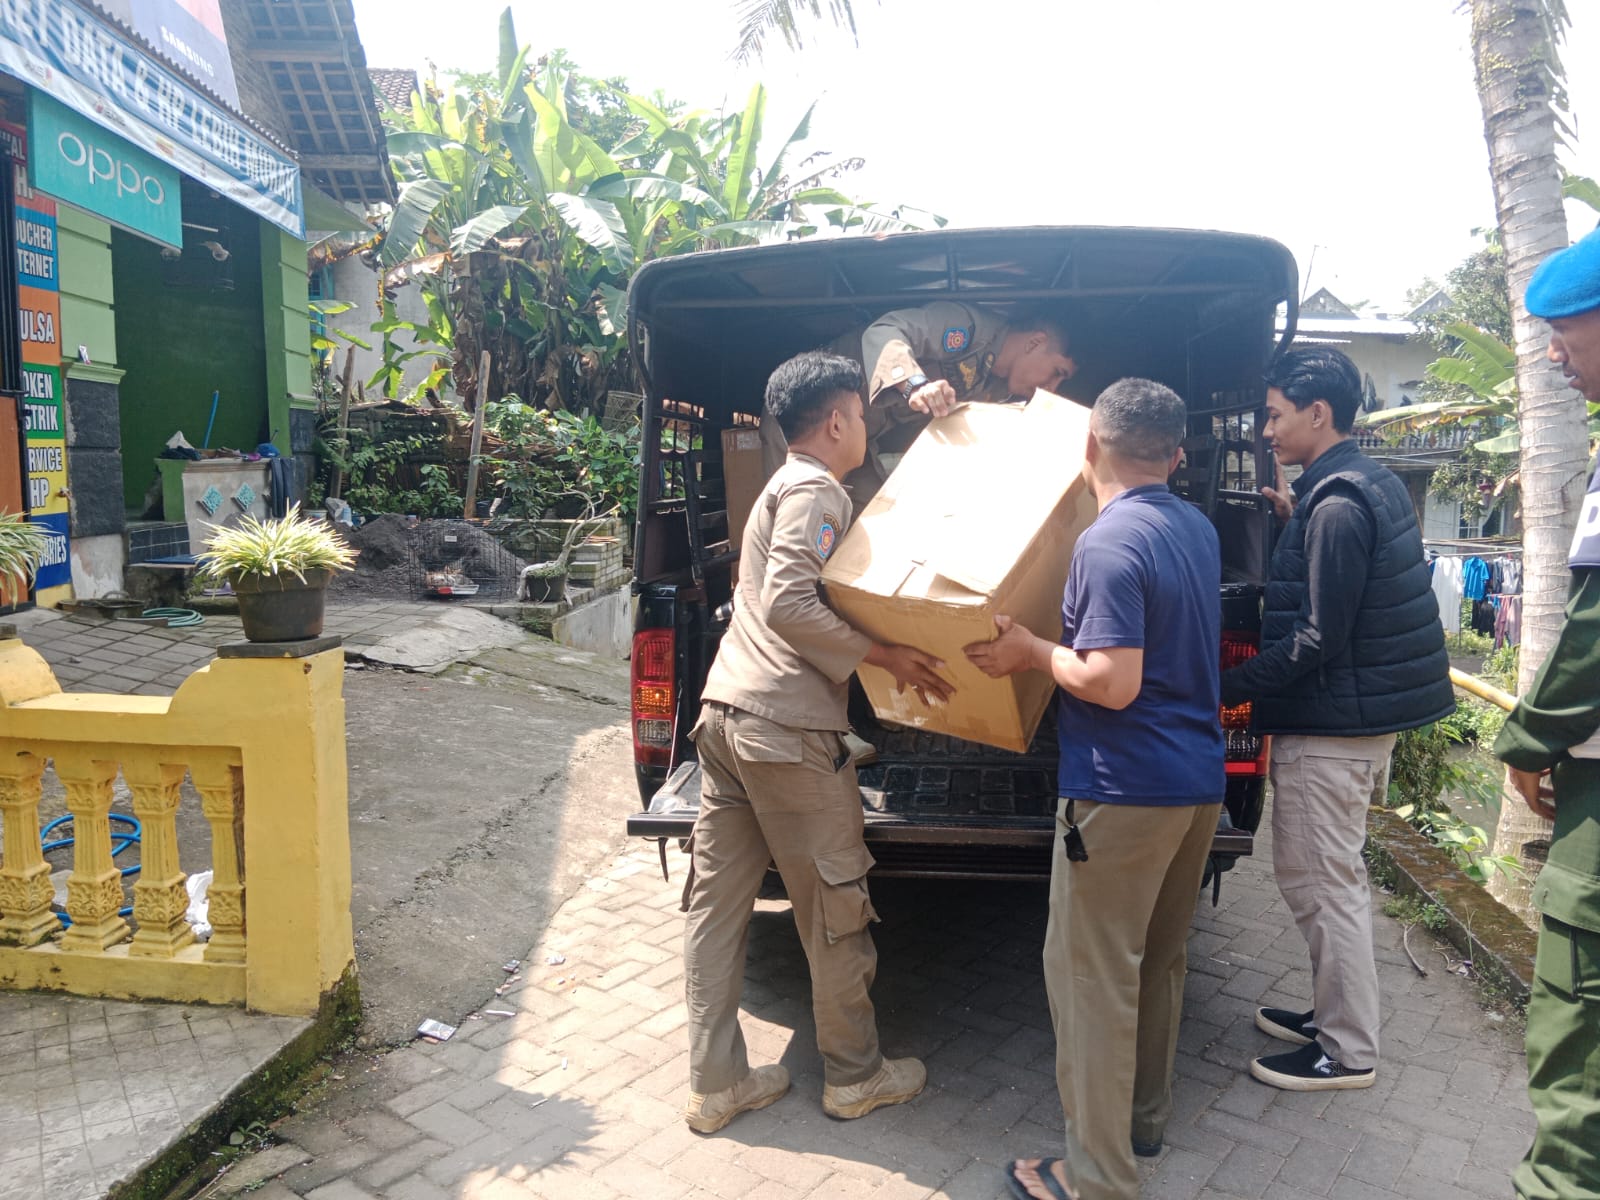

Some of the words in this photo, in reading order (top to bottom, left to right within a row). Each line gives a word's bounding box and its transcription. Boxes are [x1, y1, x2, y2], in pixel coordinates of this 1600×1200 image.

[61, 5, 126, 98] DATA
[160, 24, 215, 78] SAMSUNG
[30, 478, 49, 507] HP
